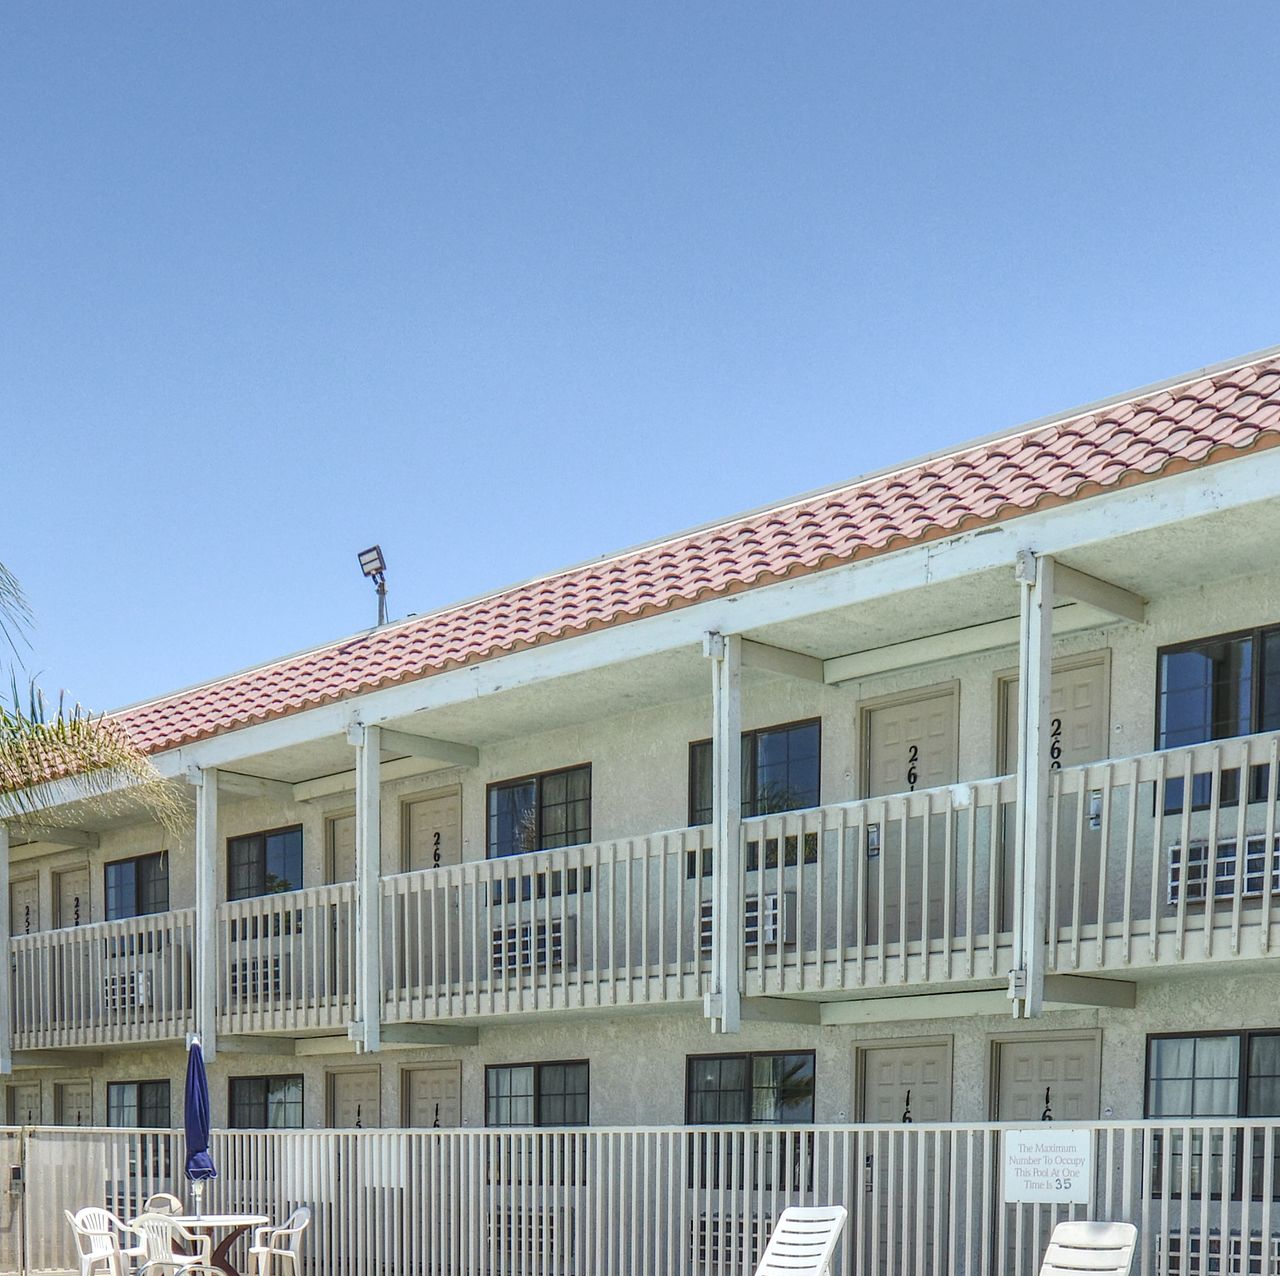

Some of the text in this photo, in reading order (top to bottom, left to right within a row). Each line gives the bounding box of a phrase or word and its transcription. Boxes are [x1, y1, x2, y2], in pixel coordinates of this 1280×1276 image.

[1018, 1143, 1077, 1153] The Maximum
[1009, 1156, 1086, 1167] Number To Occupy
[1015, 1168, 1080, 1177] This Pool At One
[1024, 1180, 1044, 1189] Time
[1055, 1178, 1072, 1190] 35
